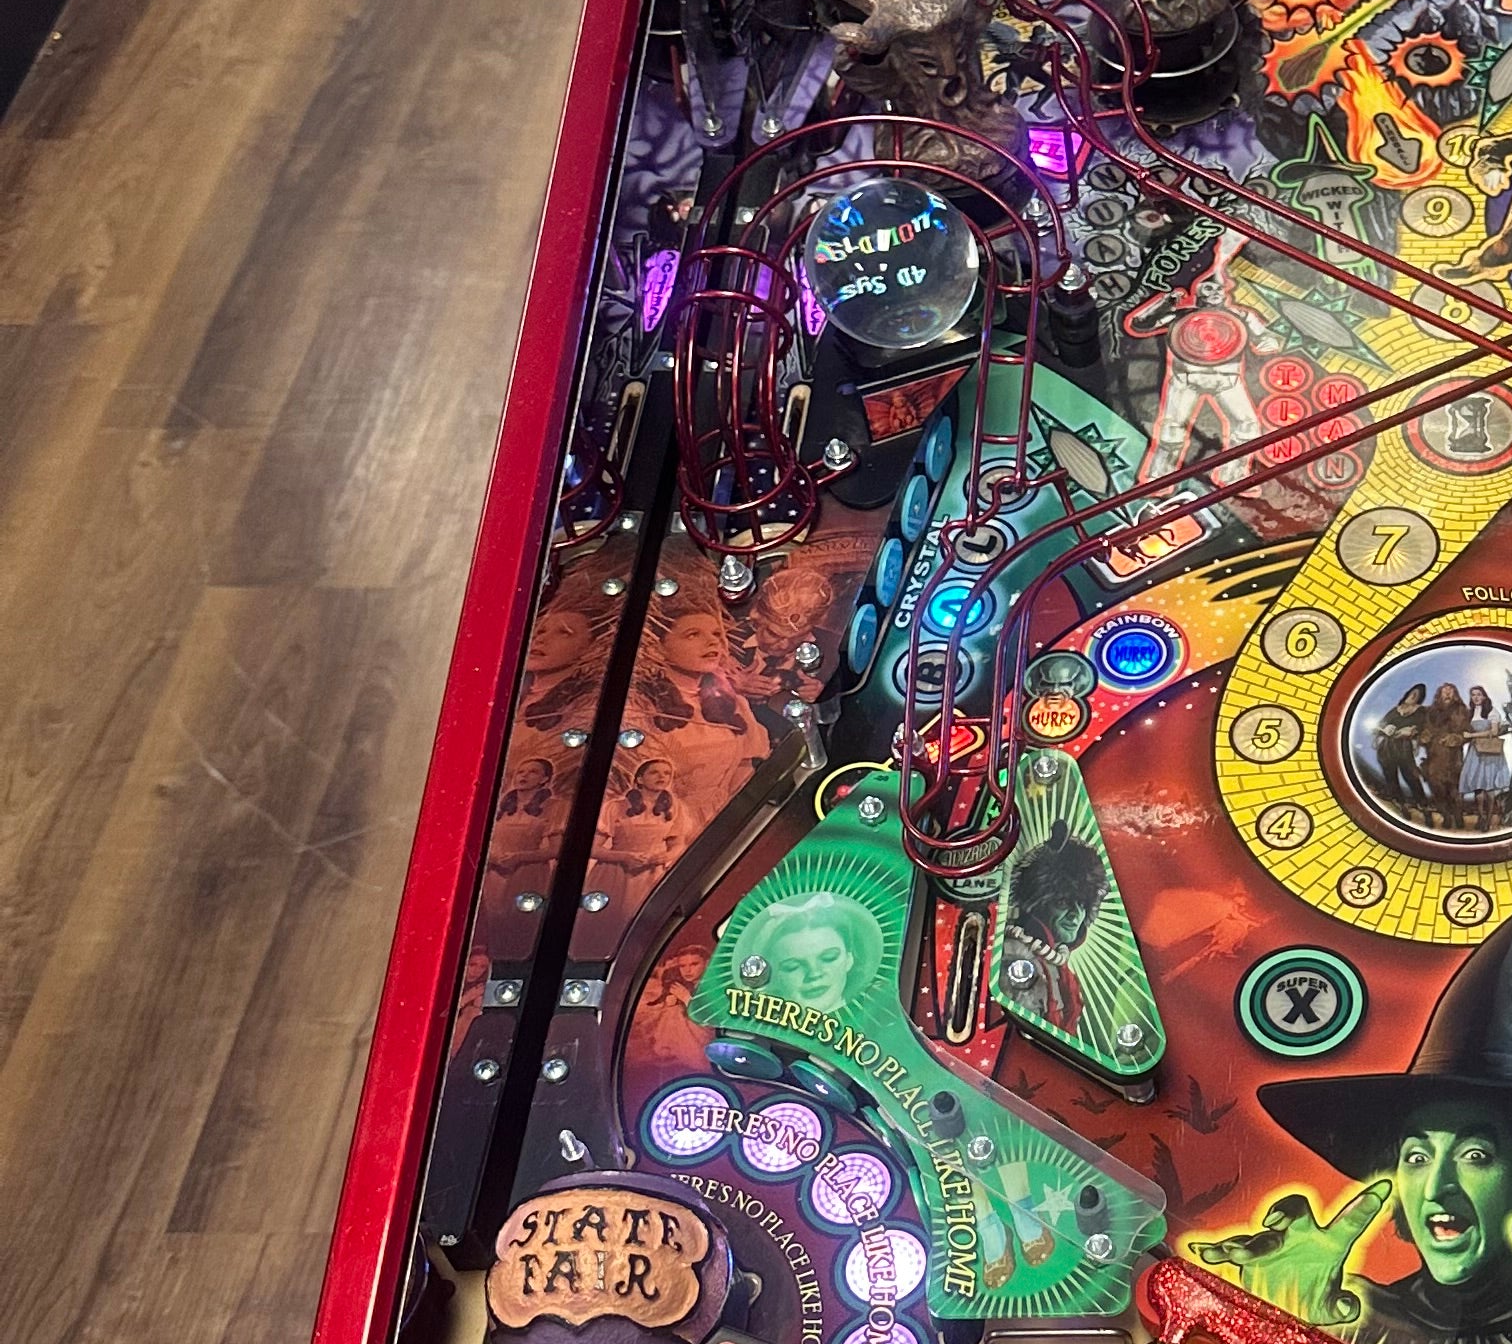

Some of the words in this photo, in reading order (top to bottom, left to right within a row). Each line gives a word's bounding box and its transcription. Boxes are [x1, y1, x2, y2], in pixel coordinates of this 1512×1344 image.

[1302, 185, 1363, 202] WICKED
[1423, 197, 1452, 225] 9
[1438, 289, 1470, 324] 8
[1372, 525, 1410, 565] 7
[895, 514, 950, 628] CRYSTAL
[1093, 615, 1180, 639] RAINBOW
[1283, 620, 1317, 656] 6
[1116, 646, 1154, 662] HURRY
[1031, 711, 1076, 726] HURRY
[1252, 716, 1282, 749] 5
[1268, 809, 1297, 841] 4
[953, 879, 996, 889] LANE
[1349, 873, 1373, 900] 3
[1457, 891, 1478, 919] 2
[1276, 978, 1328, 995] SUPER
[1283, 987, 1320, 1024] X
[725, 988, 839, 1043] THERE'S
[834, 1027, 881, 1066] NO
[944, 1201, 978, 1298] HOME
[670, 1105, 779, 1140] THERE'S
[776, 1124, 820, 1162] NO
[814, 1152, 879, 1227] PLACE
[860, 1224, 897, 1282] LIKE
[509, 1205, 682, 1252] STATE
[731, 1190, 765, 1220] NO
[760, 1214, 812, 1271] PLACE
[796, 1268, 823, 1316] LIKE
[519, 1250, 660, 1300] FAIR
